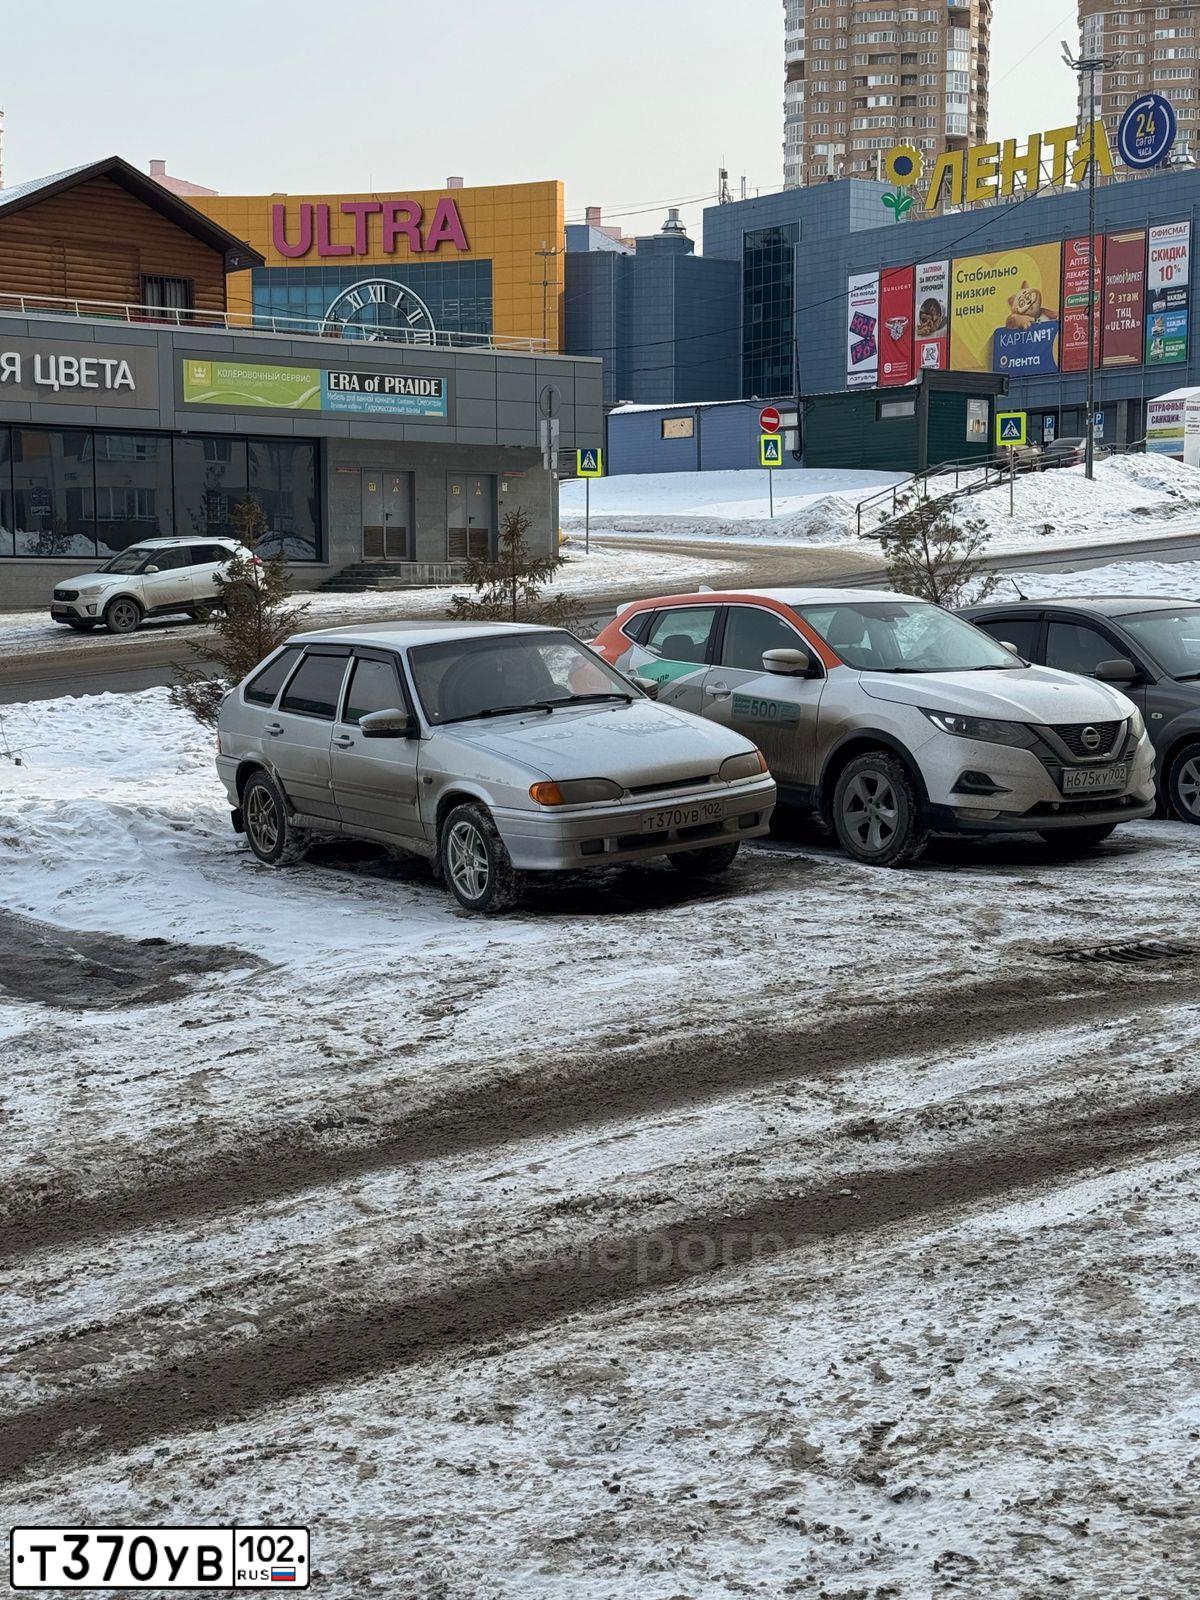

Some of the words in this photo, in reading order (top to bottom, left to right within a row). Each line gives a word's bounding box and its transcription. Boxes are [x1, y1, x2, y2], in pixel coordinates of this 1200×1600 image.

[1136, 111, 1155, 138] 24
[925, 120, 1113, 210] ЛЕНТА
[272, 197, 469, 258] ULTRA
[1151, 226, 1188, 239] ОФИСМАГ
[1070, 255, 1098, 267] АПТЕА
[1151, 246, 1187, 263] СКИДКА
[956, 265, 1018, 284] Стабильно
[1065, 267, 1101, 280] ЛЕКАРСВА
[1159, 264, 1181, 282] 10%
[367, 285, 386, 303] XII
[883, 283, 911, 293] SUNLIGHT
[955, 286, 996, 300] низкие
[1109, 292, 1115, 304] 2
[1118, 292, 1139, 303] этаж
[955, 304, 984, 319] цены
[1105, 319, 1141, 331] «ULTRA»
[1008, 356, 1041, 368] лента
[0, 352, 21, 383] Я
[34, 354, 136, 392] ЦВЕТА
[217, 368, 280, 380] КОЛЕРОВОЧНЫЙ
[281, 373, 311, 383] СЕРВИС
[330, 374, 360, 391] ERA
[364, 375, 380, 392] of
[384, 377, 440, 396] PRAIDE
[751, 699, 777, 718] 500
[1067, 771, 1108, 788] Н675КУ
[1110, 768, 1125, 780] 702
[647, 810, 699, 829] Т370УВ
[702, 802, 720, 816] 102
